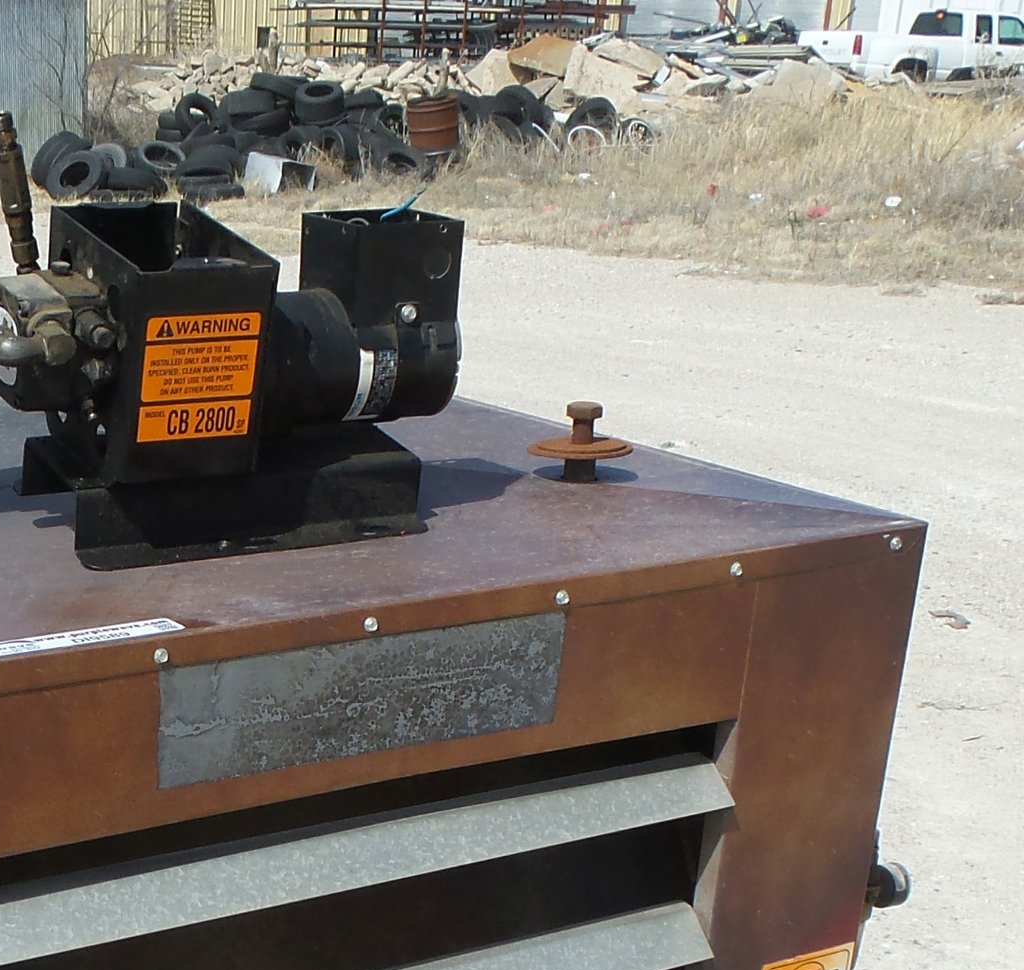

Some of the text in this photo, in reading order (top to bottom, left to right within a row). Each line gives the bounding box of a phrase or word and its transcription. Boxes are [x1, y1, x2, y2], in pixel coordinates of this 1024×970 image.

[176, 318, 250, 334] WARNING
[173, 347, 186, 355] THIS
[188, 346, 205, 354] PUMP
[224, 345, 231, 353] BE
[150, 358, 183, 367] INSTALLED
[184, 357, 199, 365] ONLY
[201, 356, 210, 364] ON
[182, 366, 201, 375] CLEAN
[203, 365, 220, 373] BURN
[163, 374, 234, 386] DO NOT USE THIS PUMP
[160, 388, 169, 396] ON
[170, 387, 183, 395] ANY
[184, 386, 204, 394] OTHER
[145, 406, 246, 435] MODEL CB 2800 SP
